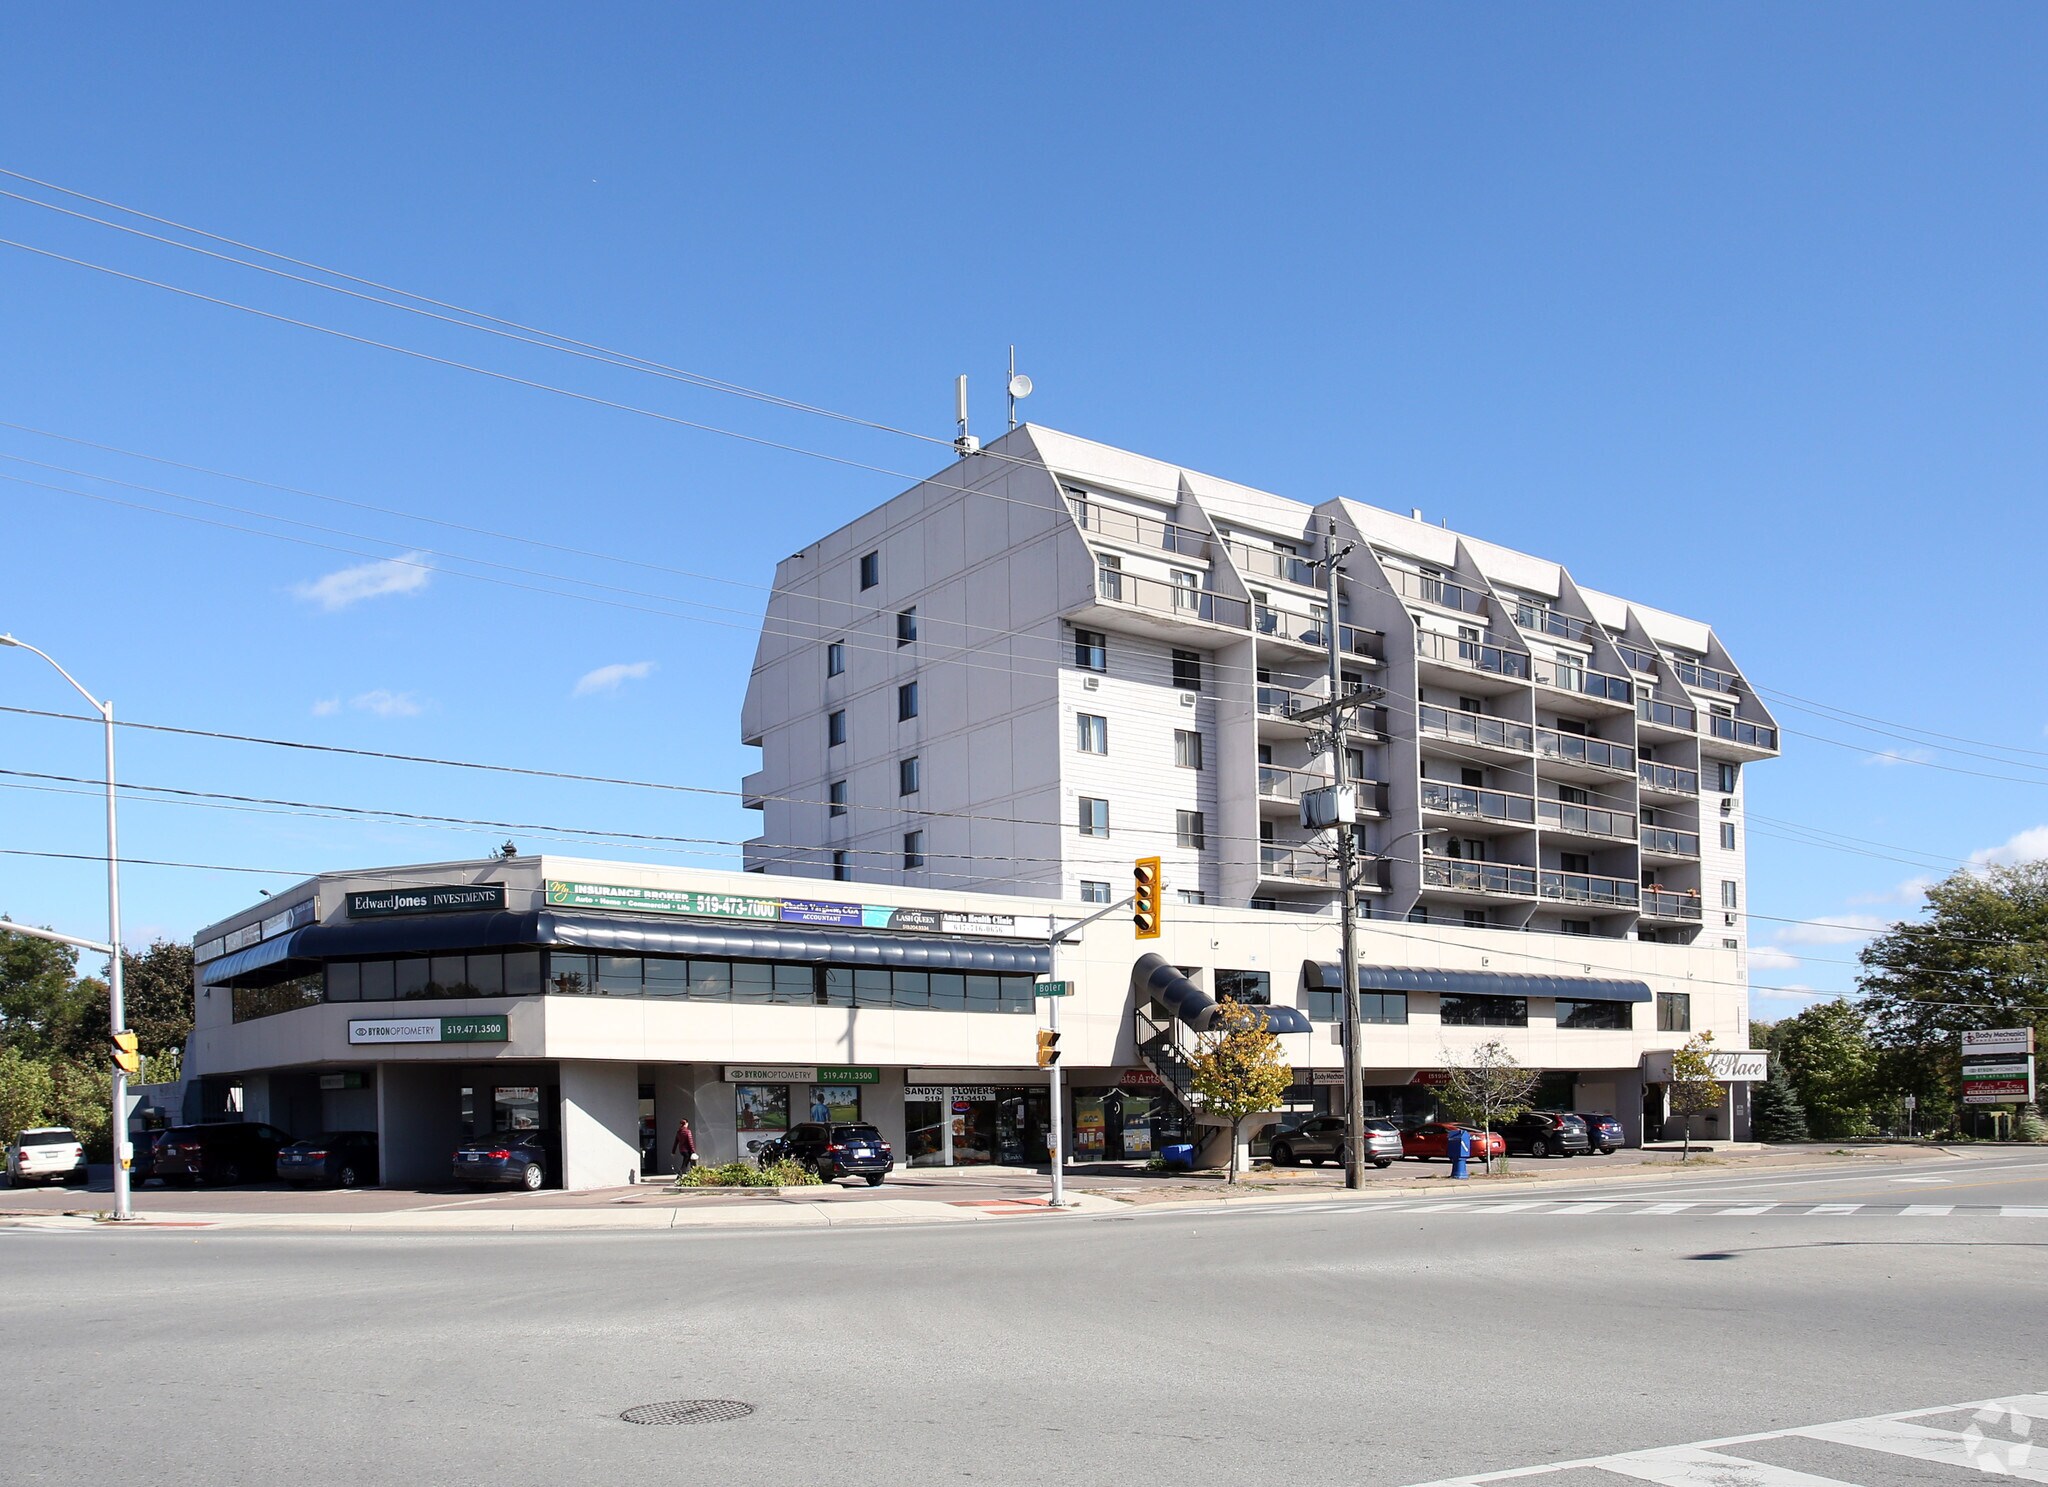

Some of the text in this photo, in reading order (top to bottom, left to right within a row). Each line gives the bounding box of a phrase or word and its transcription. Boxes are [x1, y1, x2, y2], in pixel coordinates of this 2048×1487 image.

[433, 890, 496, 905] INVESTMENTS
[550, 881, 689, 903] My INSURANCE BROKER
[575, 896, 690, 911] Auto Home Commercial Life
[696, 895, 775, 917] 519-473-7000
[802, 913, 841, 922] ACCOUNTANT
[895, 914, 935, 924] LASH QUEEN
[942, 913, 1013, 925] Anna's Health Clinic
[1039, 983, 1062, 993] Boler
[447, 1024, 501, 1034] 519.471.3500
[1976, 1030, 2026, 1039] Body Mechanics
[1719, 1054, 1765, 1076] Place
[823, 1069, 873, 1080] 519.471.3500
[1137, 1073, 1161, 1084] Arts
[1314, 1072, 1326, 1080] Body
[904, 1087, 995, 1095] SANDYS FLOWERS
